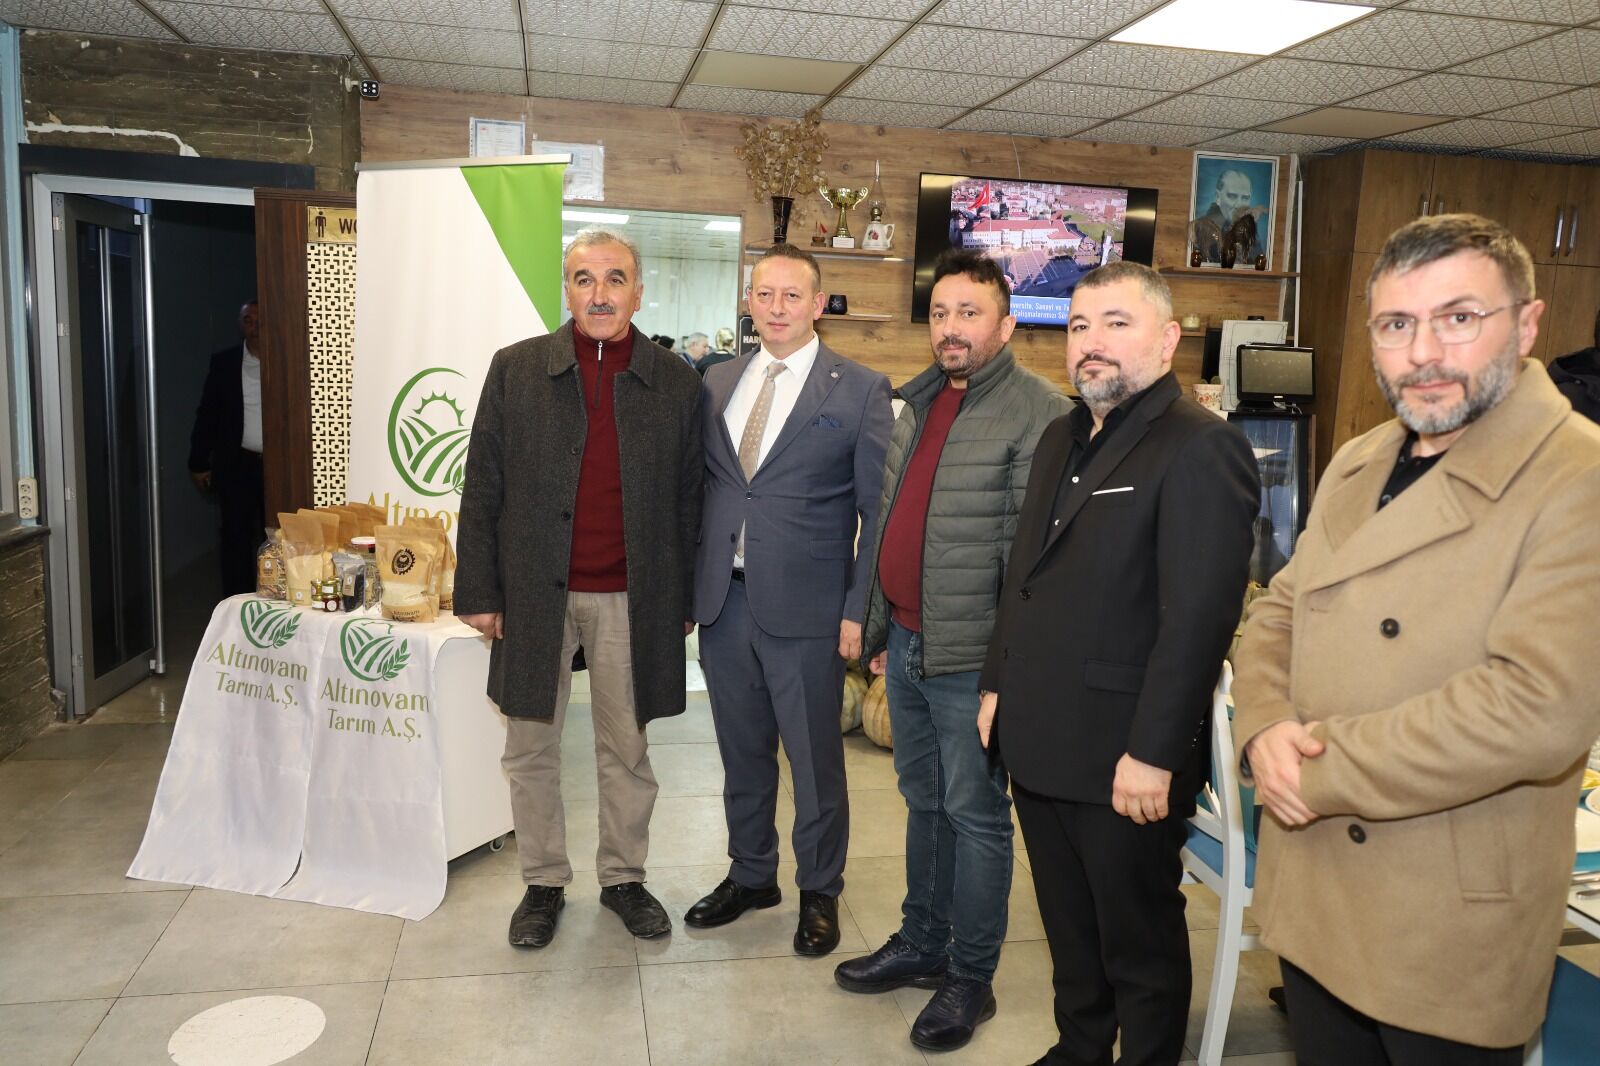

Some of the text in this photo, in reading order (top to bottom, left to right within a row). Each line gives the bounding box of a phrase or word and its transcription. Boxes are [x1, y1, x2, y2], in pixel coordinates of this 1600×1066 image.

[207, 642, 308, 682] Altınovam
[216, 671, 262, 699] Tarım
[320, 677, 430, 713] Altınovam
[327, 708, 422, 744] Tarım A.Ş.
